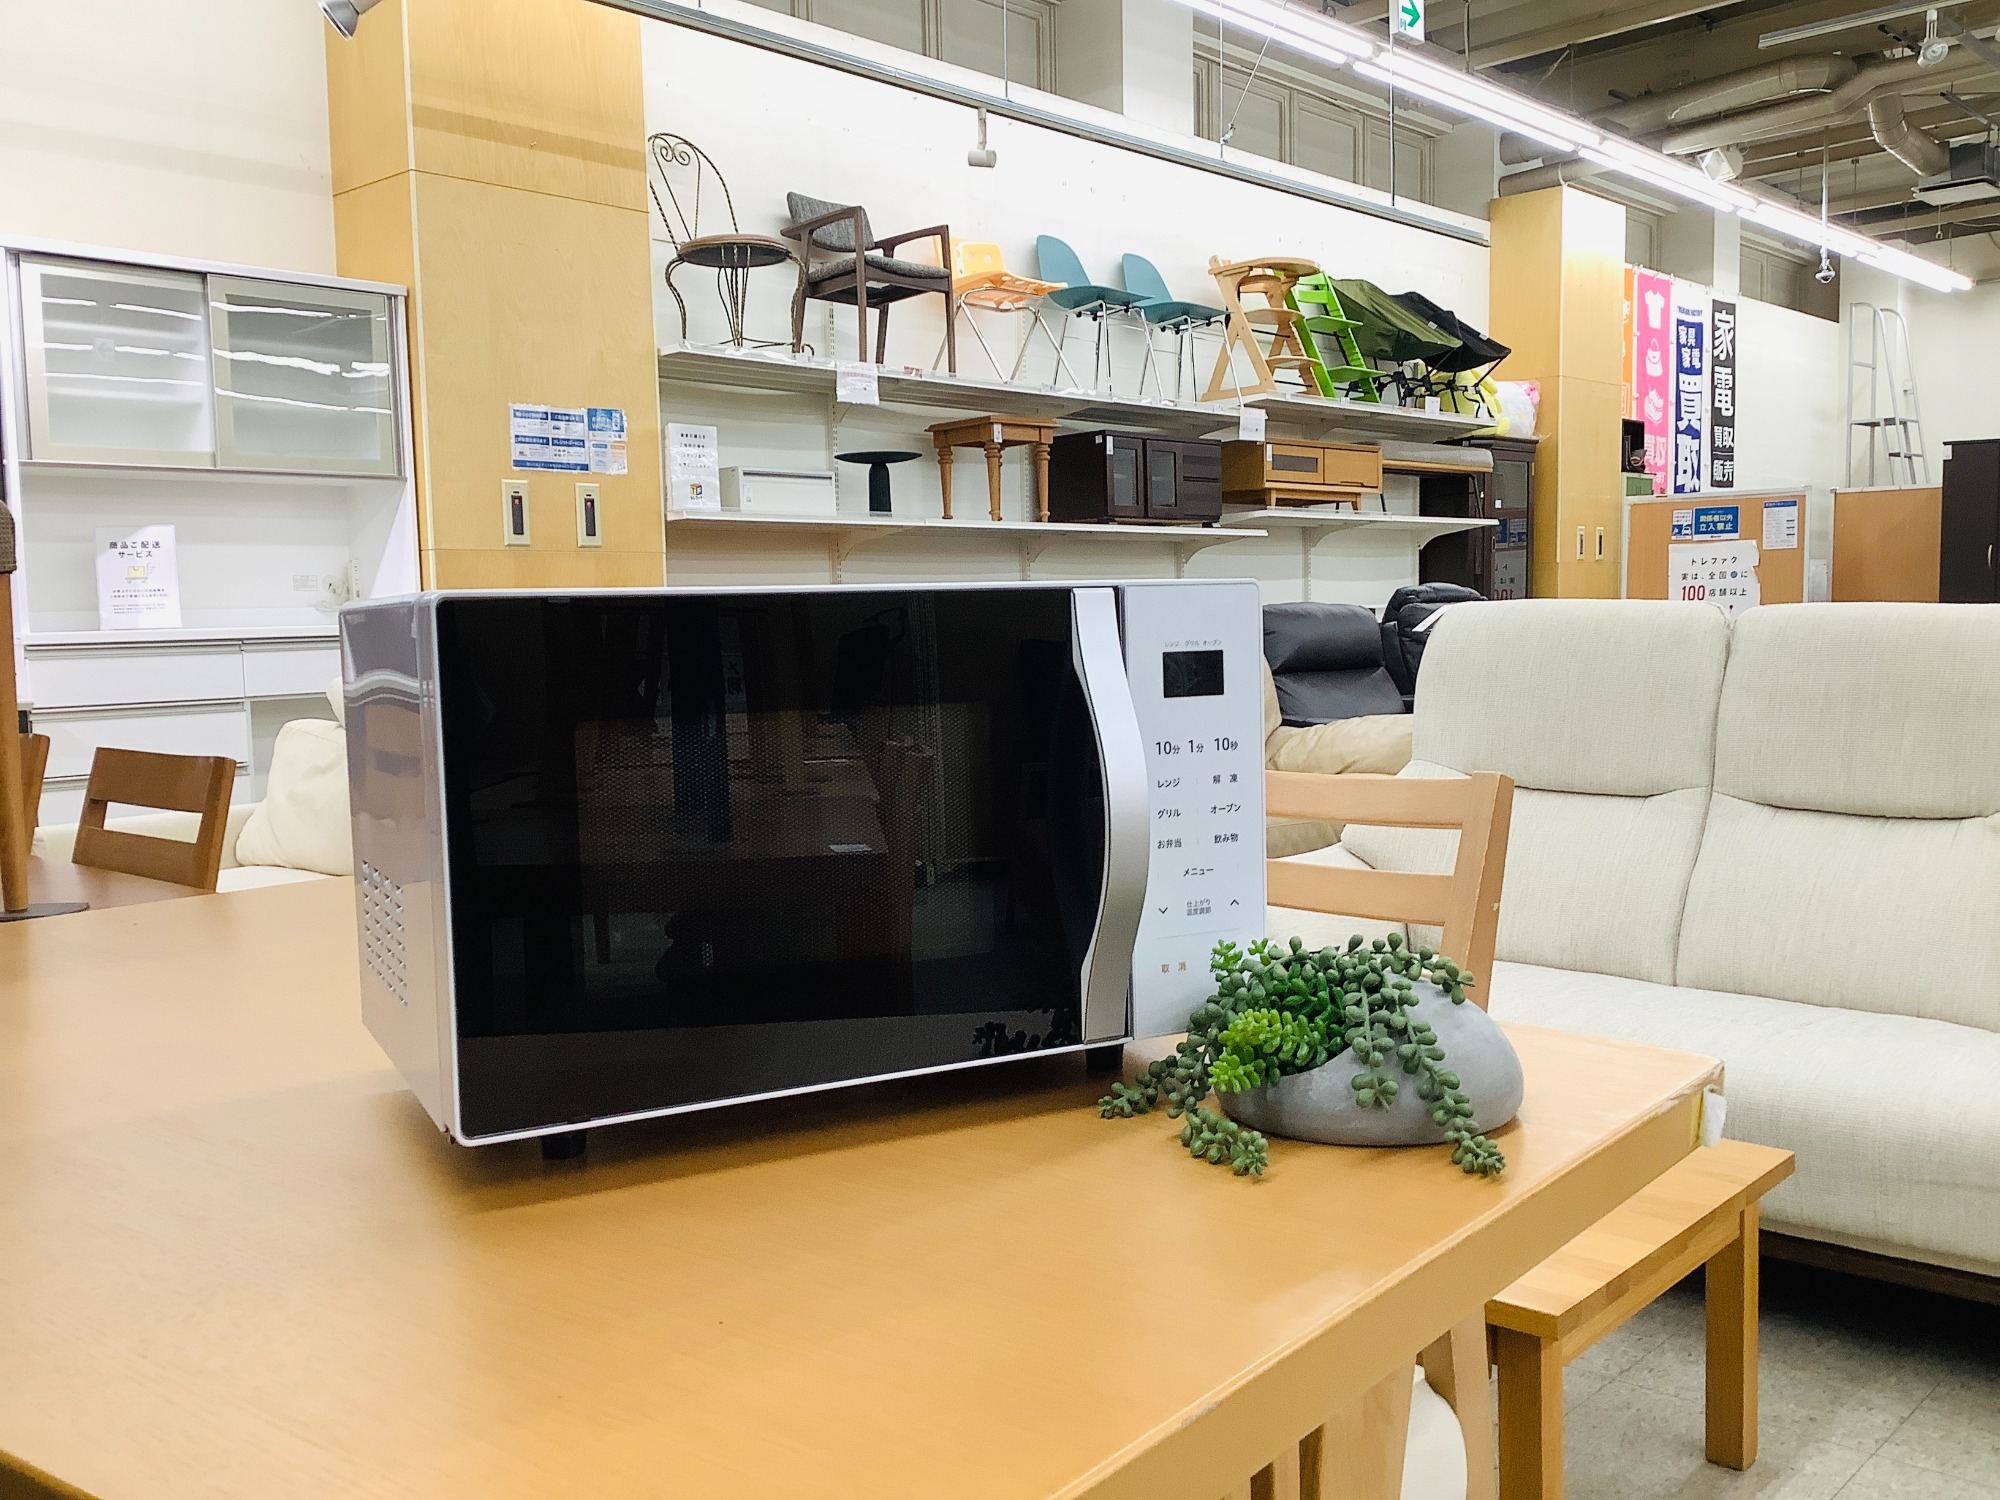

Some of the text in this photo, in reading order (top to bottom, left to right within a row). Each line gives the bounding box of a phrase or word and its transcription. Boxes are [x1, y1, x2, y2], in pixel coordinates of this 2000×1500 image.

[1678, 325, 1696, 347] 家具
[1681, 347, 1701, 370] 家電
[1713, 310, 1734, 417] 家電
[1677, 373, 1702, 493] 買取
[1713, 425, 1734, 448] 買取
[1712, 460, 1734, 482] 販売
[1699, 522, 1733, 531] 立入禁止
[109, 541, 161, 549] 商品ご配送
[118, 550, 153, 558] サービス
[1691, 556, 1738, 566] トレファク
[1156, 737, 1239, 755] 10分 1分 10秒
[1157, 777, 1181, 788] レンジ
[1157, 803, 1242, 819] グリル オーブン
[1157, 832, 1239, 849] お弁当 飲み物
[1183, 868, 1215, 877] メニュー
[1186, 898, 1211, 908] 仕上がり
